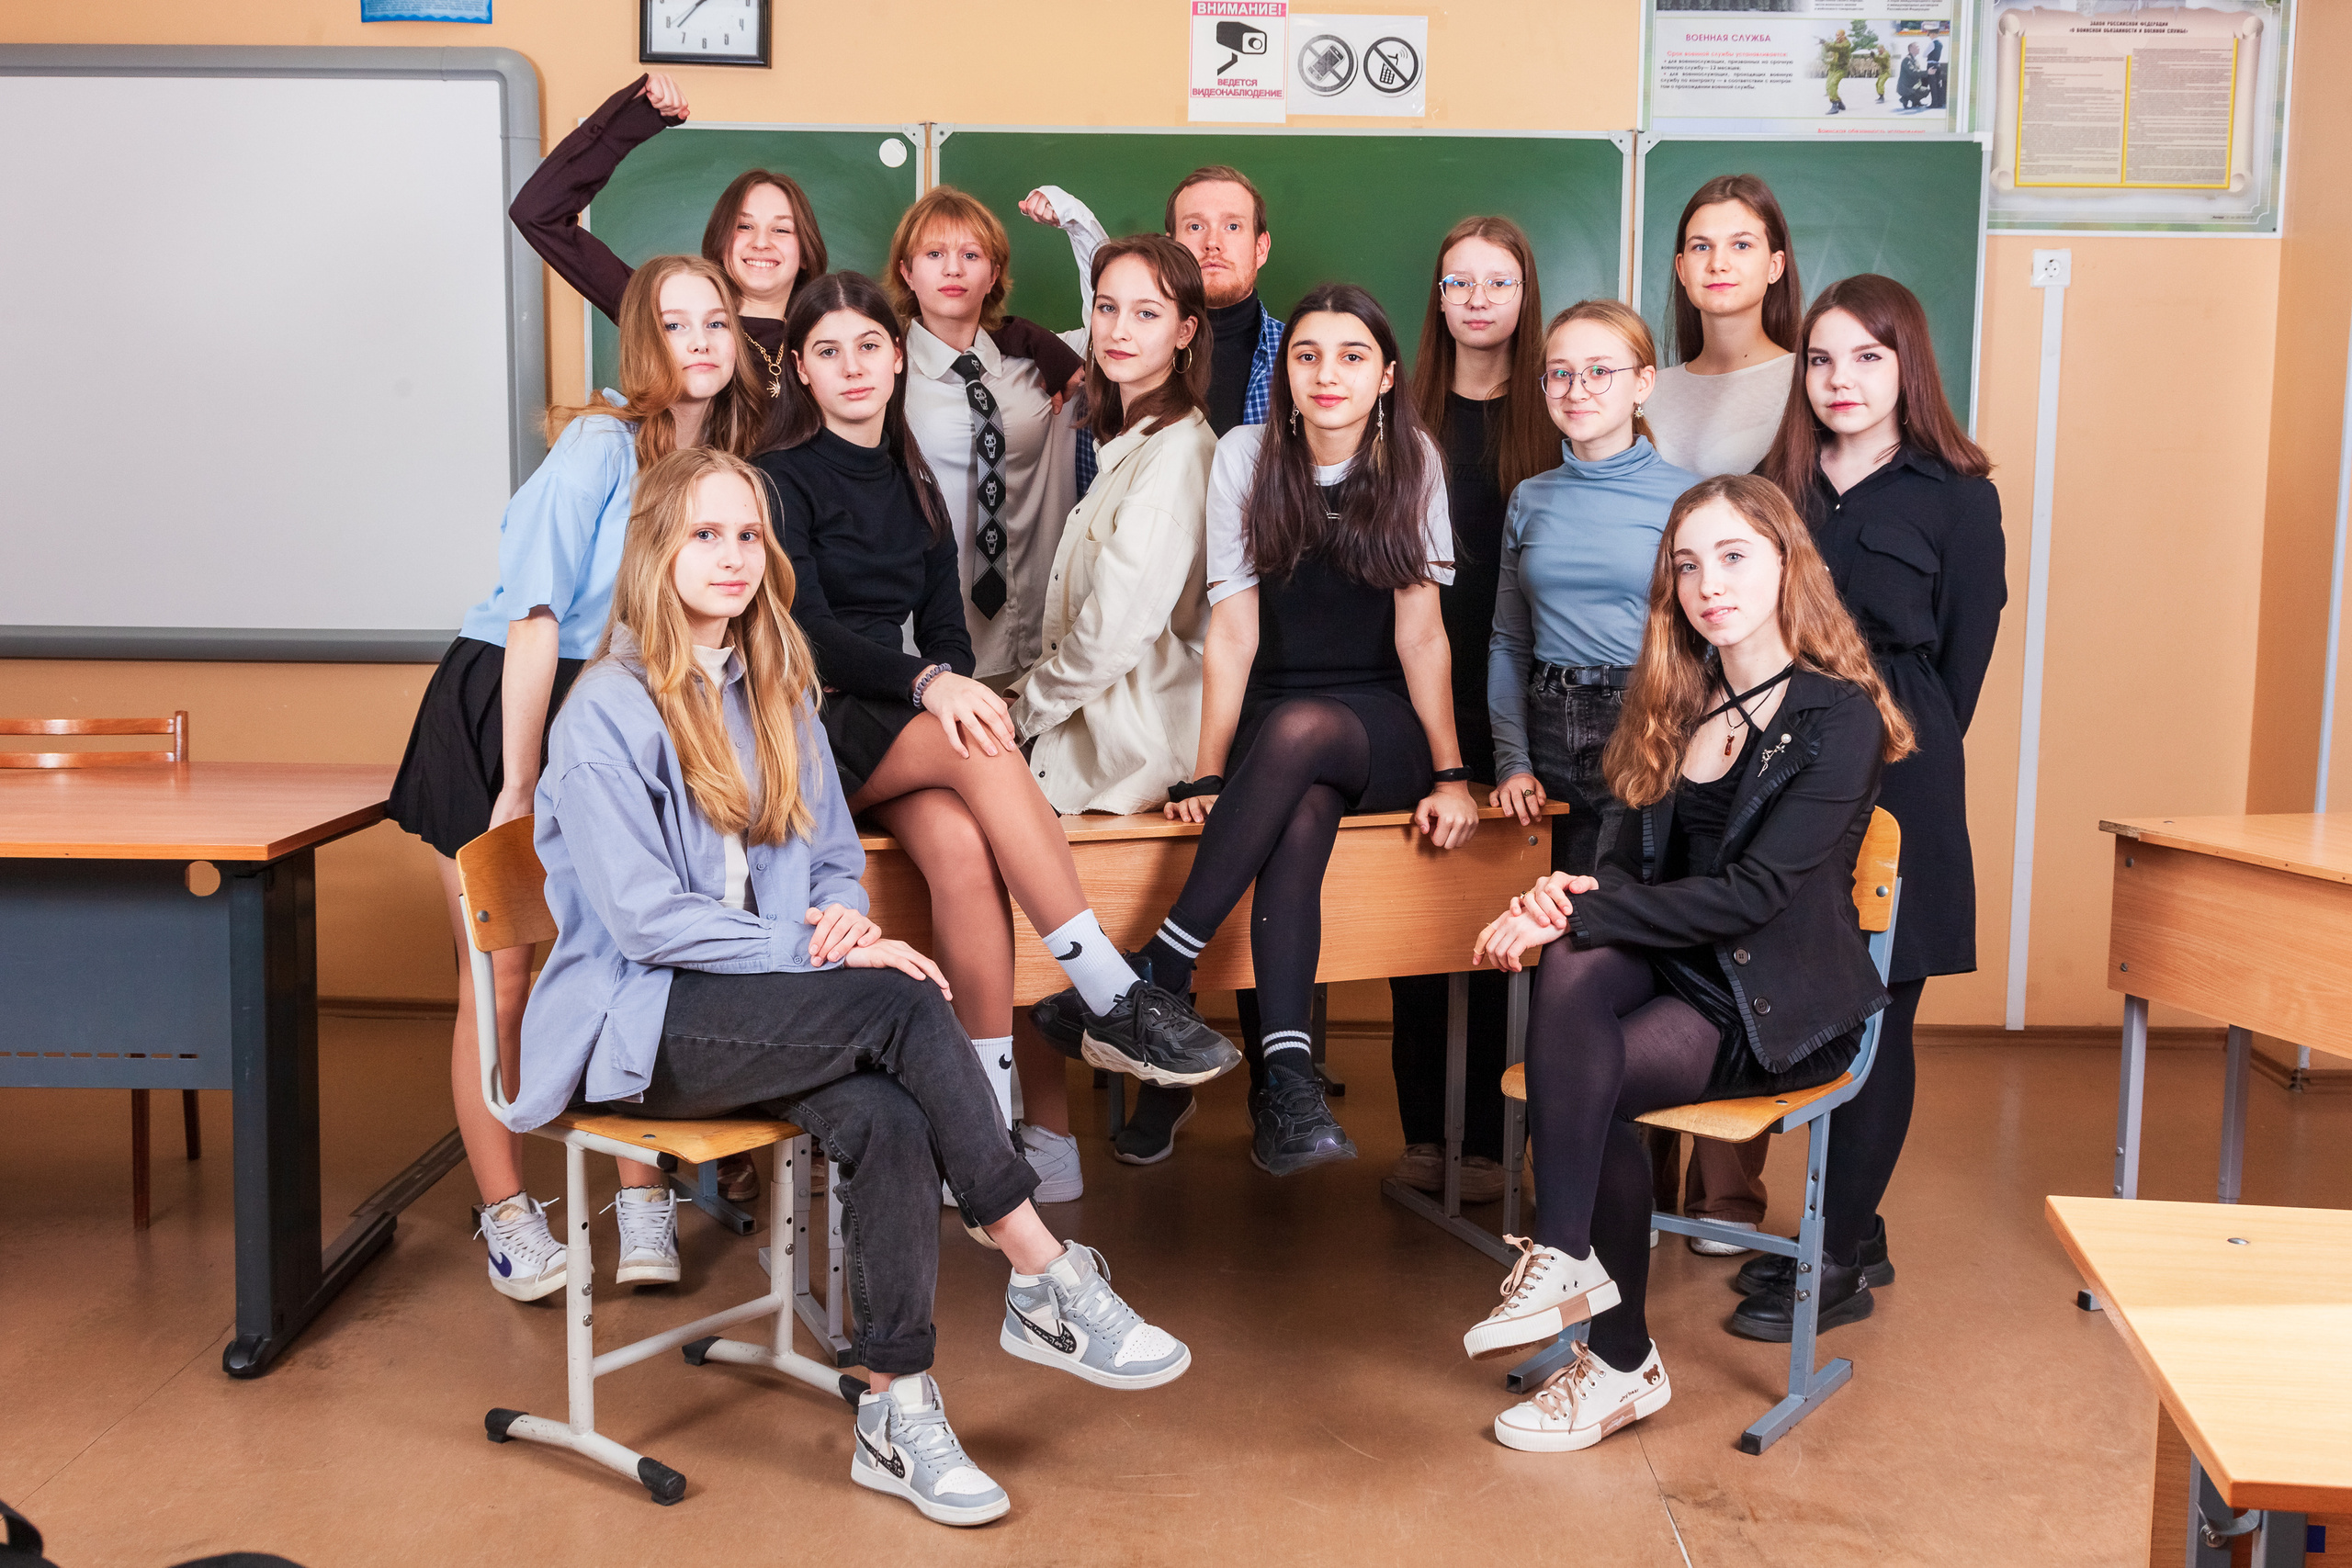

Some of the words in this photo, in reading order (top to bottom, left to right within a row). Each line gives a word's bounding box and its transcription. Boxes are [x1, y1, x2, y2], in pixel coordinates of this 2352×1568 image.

[1197, 2, 1282, 15] ВНИМАНИЕ!
[666, 17, 671, 28] 8
[740, 18, 744, 31] 4
[682, 32, 685, 44] 7
[702, 38, 707, 49] 6
[724, 34, 729, 45] 5
[1192, 89, 1282, 98] ВИДЕОНАБЛЮДЕНИЕ
